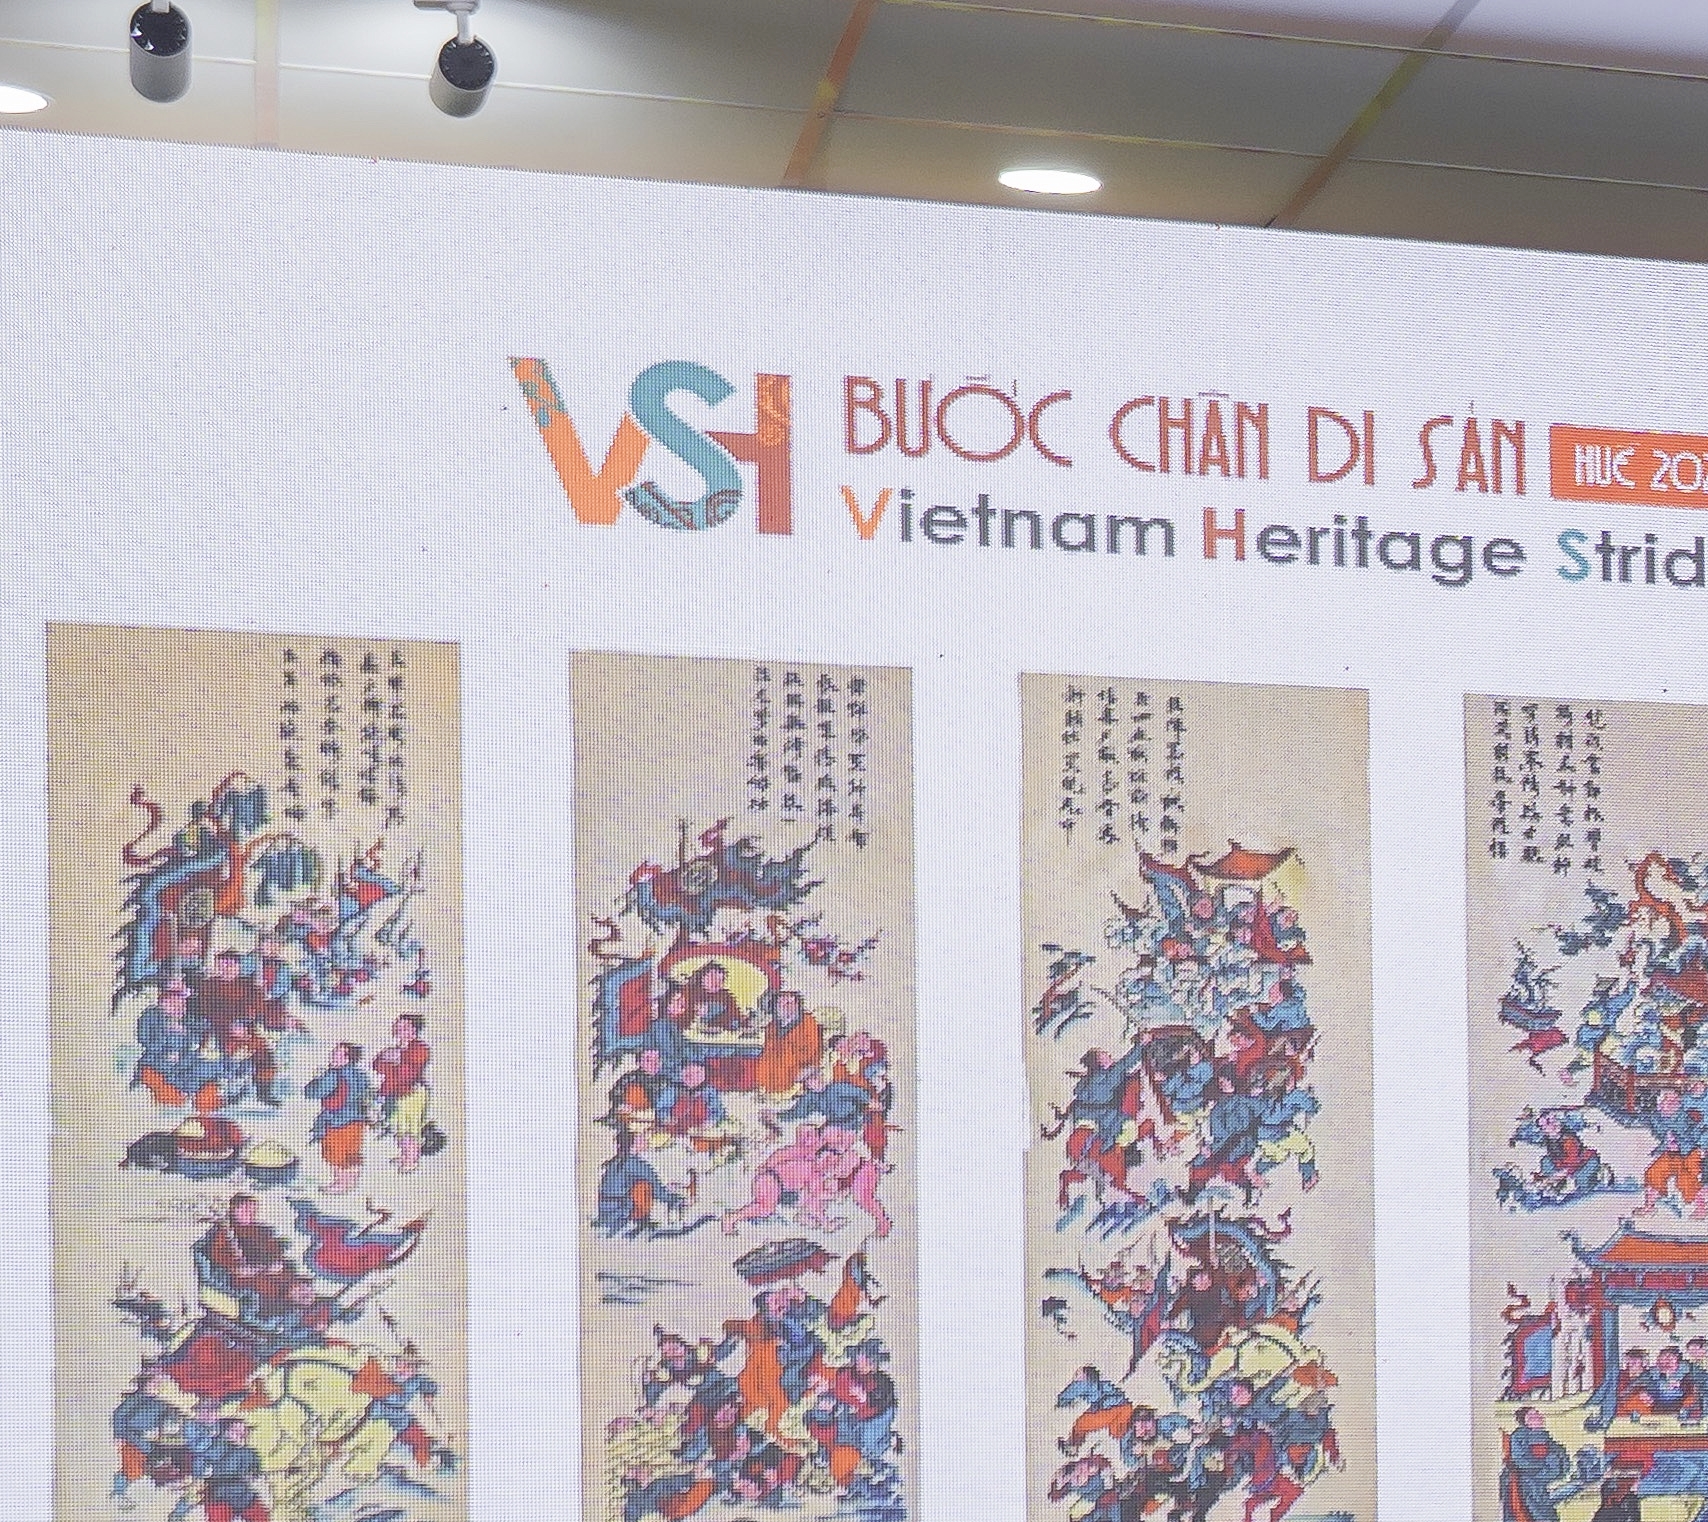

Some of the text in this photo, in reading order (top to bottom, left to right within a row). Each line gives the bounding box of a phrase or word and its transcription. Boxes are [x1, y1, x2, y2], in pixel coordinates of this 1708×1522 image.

[1307, 405, 1375, 486] DI
[841, 485, 1176, 557] Vietnam
[1203, 508, 1527, 588] Heritage
